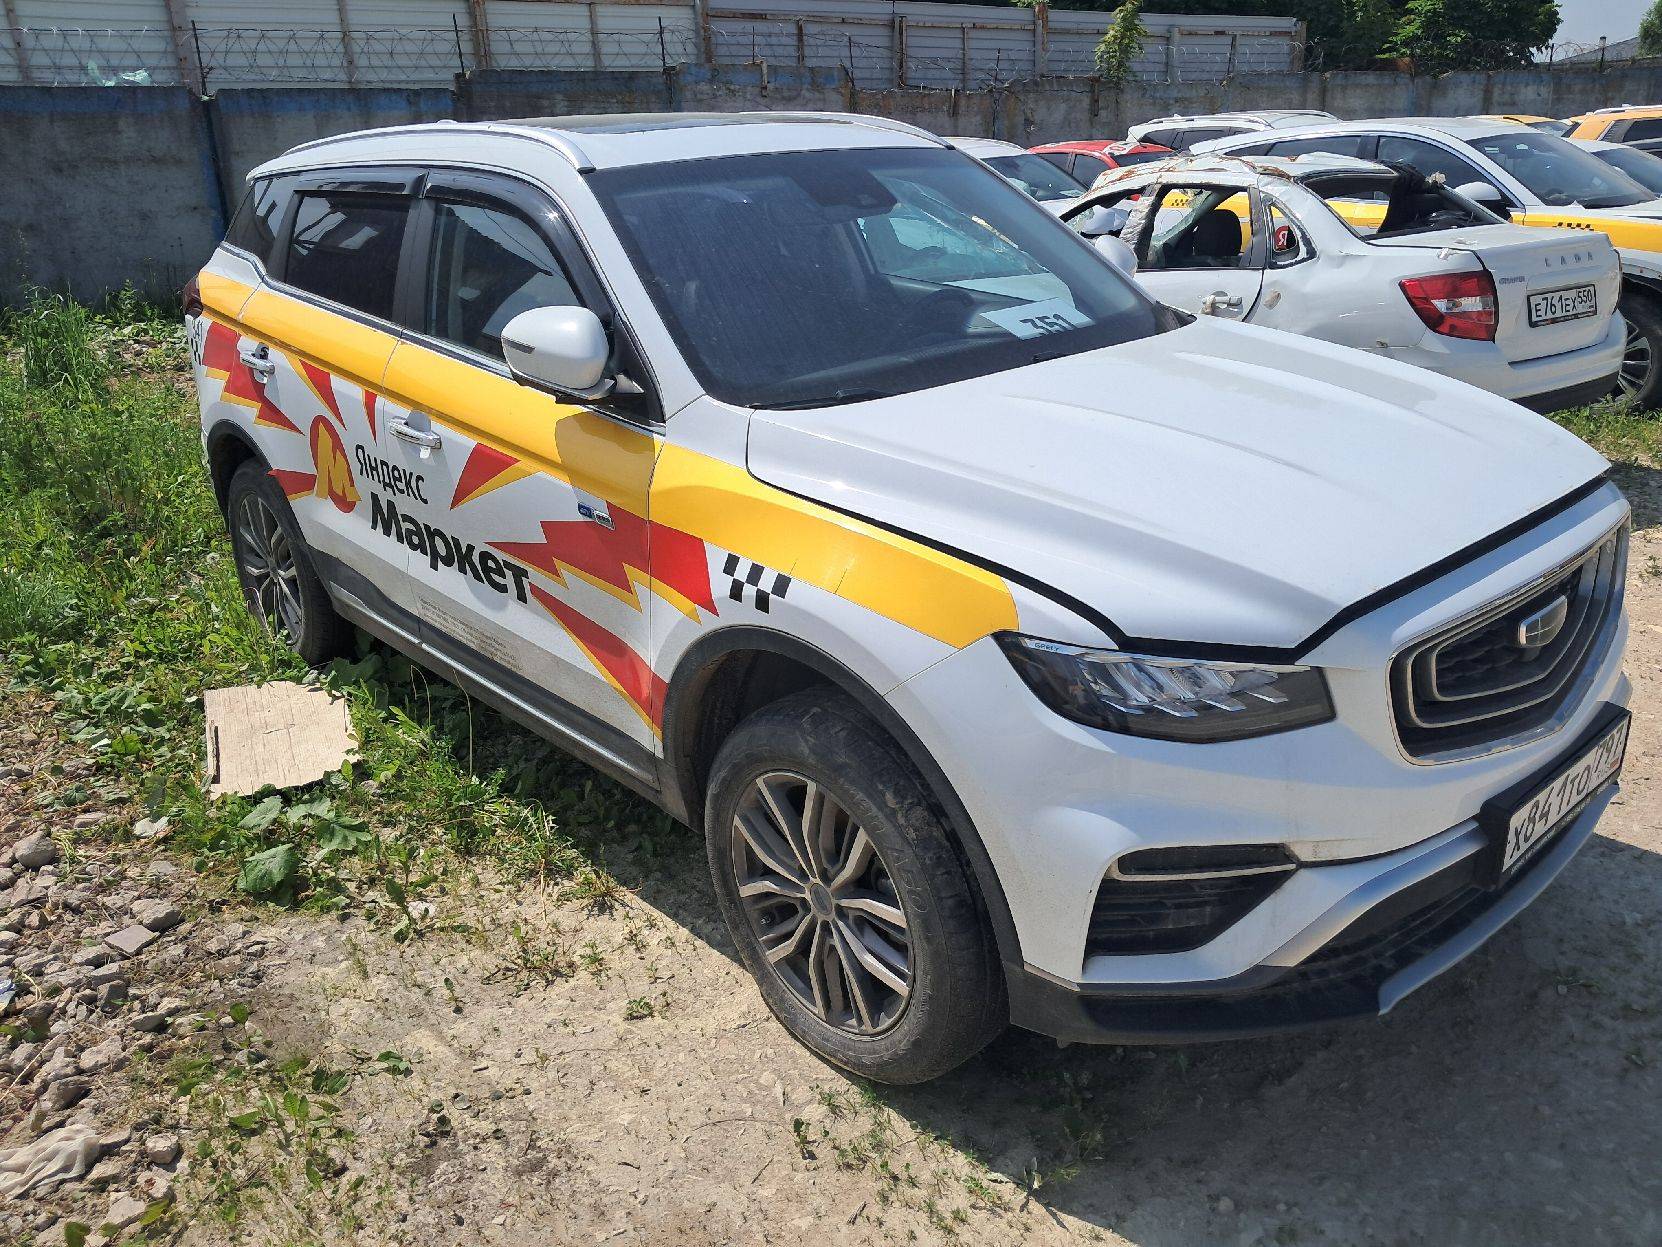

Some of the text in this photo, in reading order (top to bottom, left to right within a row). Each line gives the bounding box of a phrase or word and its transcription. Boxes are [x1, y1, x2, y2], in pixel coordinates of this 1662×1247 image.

[1545, 252, 1593, 267] LADA
[1019, 313, 1078, 336] 351
[354, 443, 429, 505] Яндекс
[370, 491, 530, 605] Маркет
